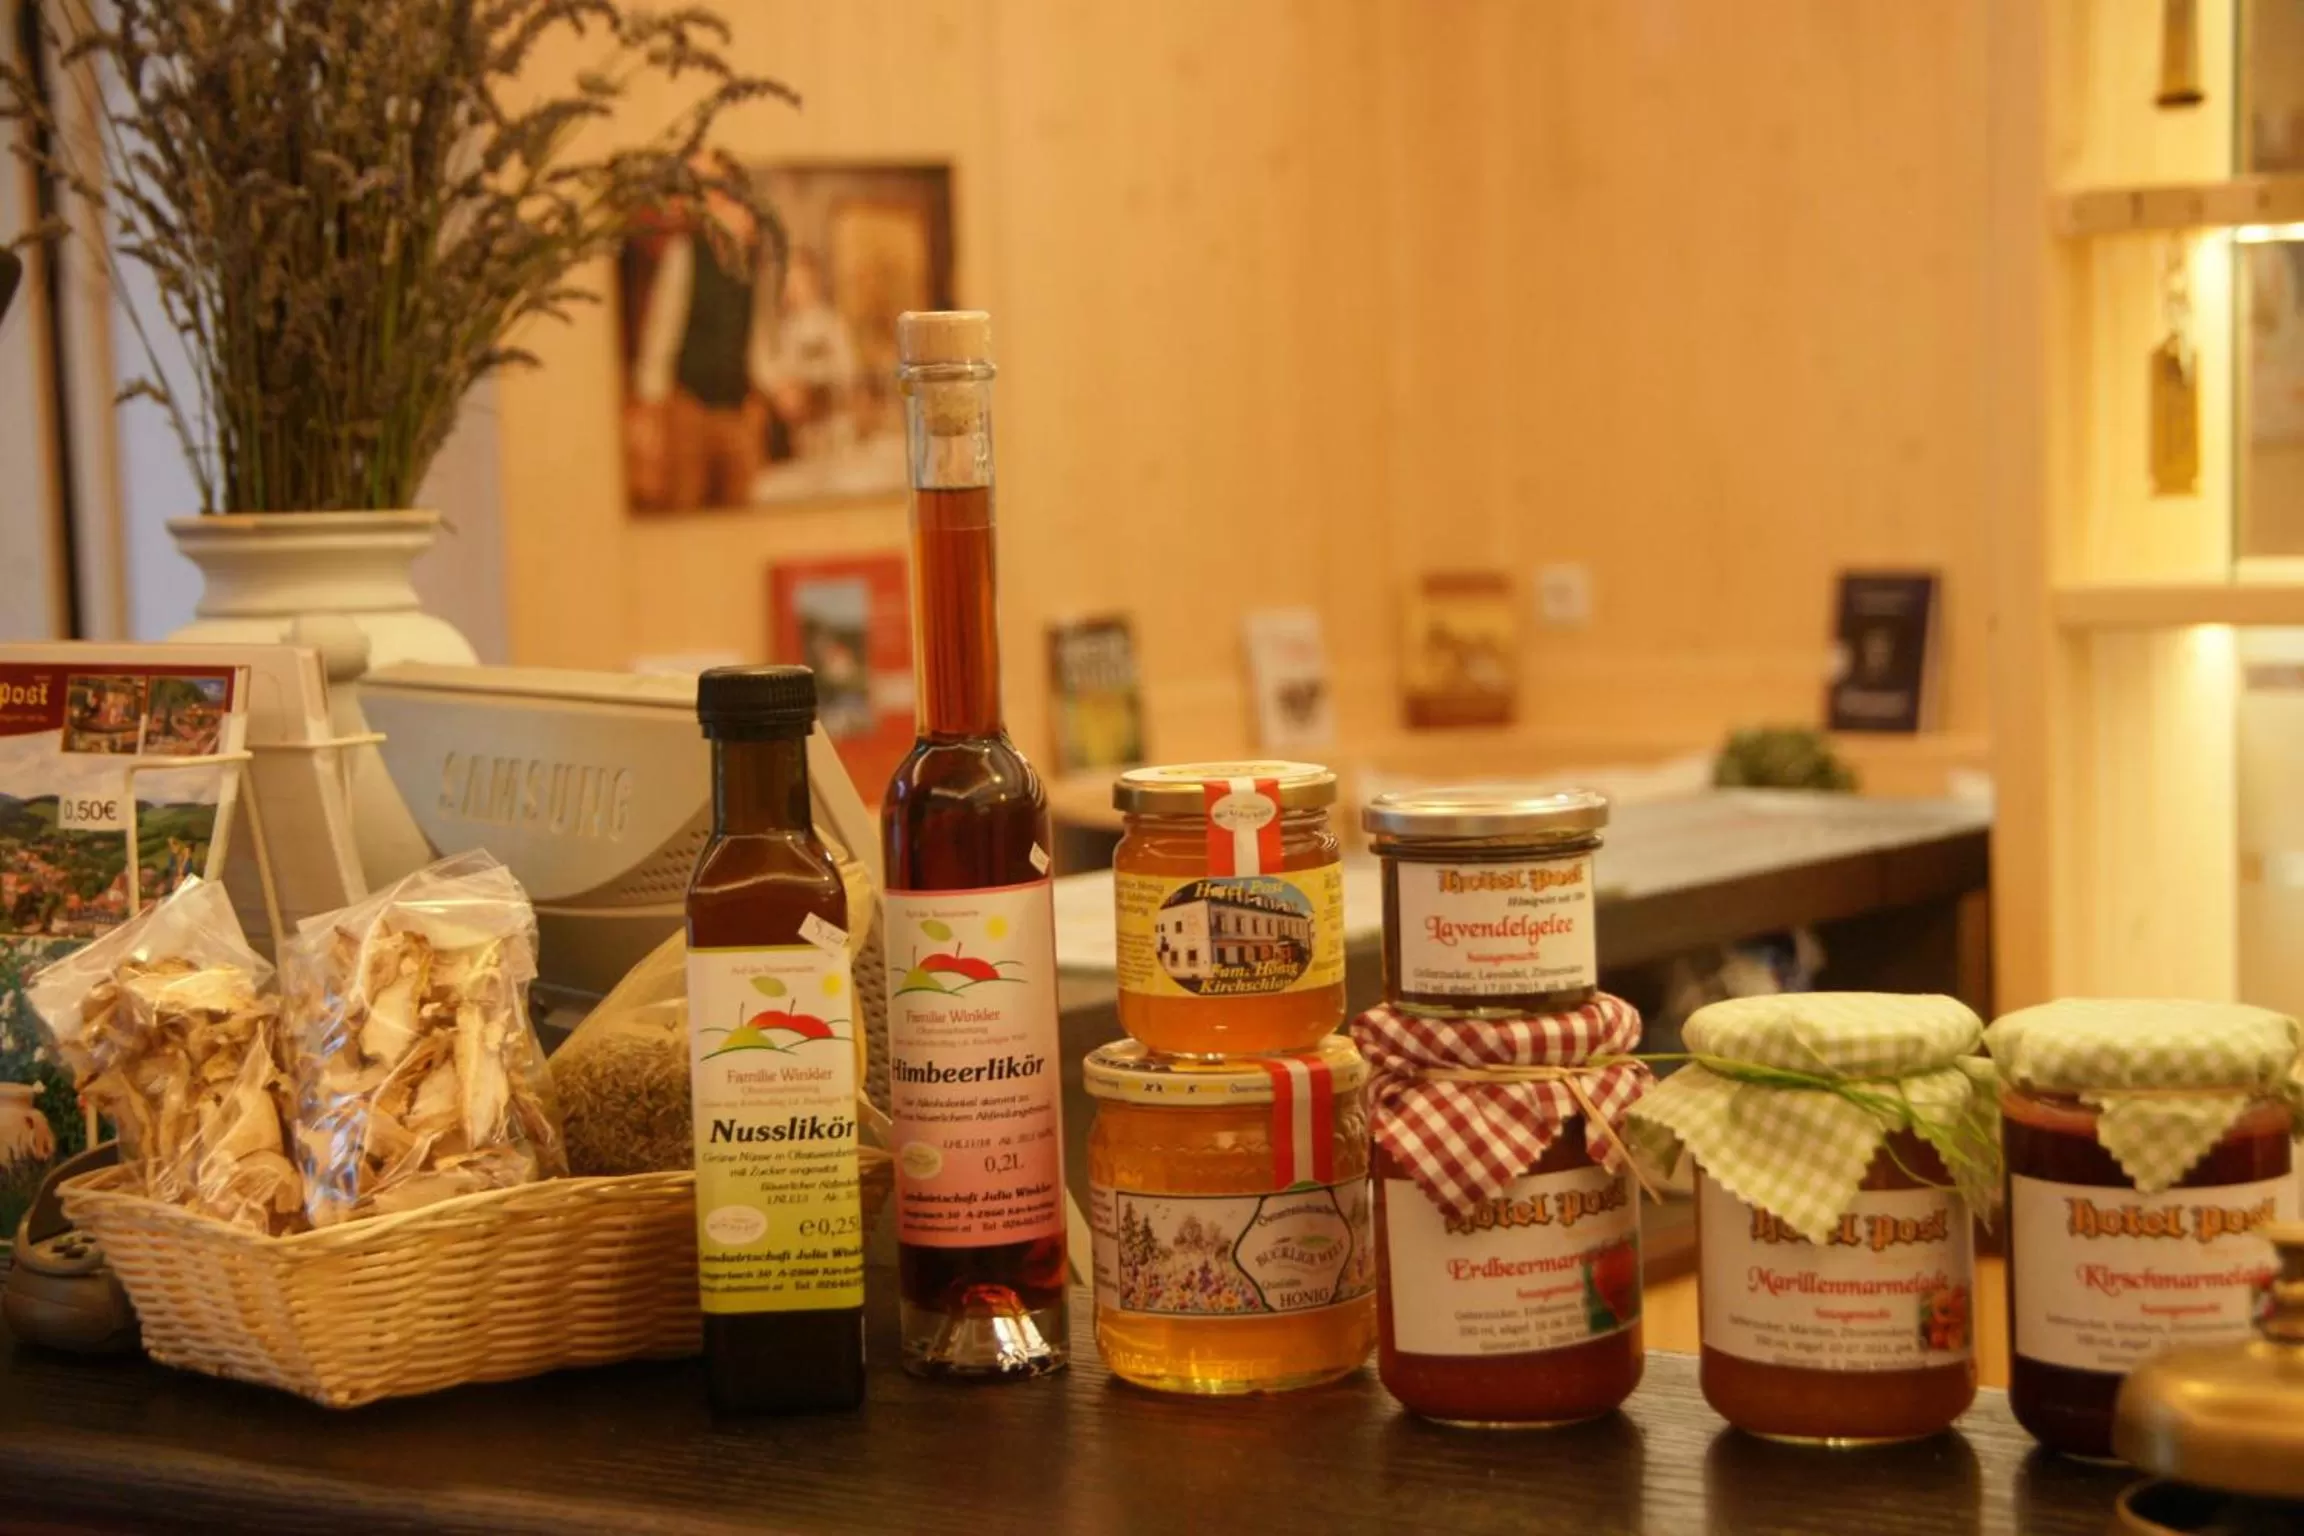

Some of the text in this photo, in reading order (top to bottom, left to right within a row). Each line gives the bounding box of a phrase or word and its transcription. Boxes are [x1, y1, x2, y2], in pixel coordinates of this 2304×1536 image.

[438, 751, 636, 841] SAMSUNG
[63, 800, 117, 821] 0,50€
[1249, 880, 1284, 895] Post
[1425, 913, 1574, 947] Lavendelgelee
[949, 1008, 1001, 1023] Winkler
[726, 1066, 833, 1084] Familie Winkler
[710, 1115, 856, 1143] Nusslikör
[1747, 1207, 1863, 1247] Hol
[1279, 1287, 1329, 1308] HONIG
